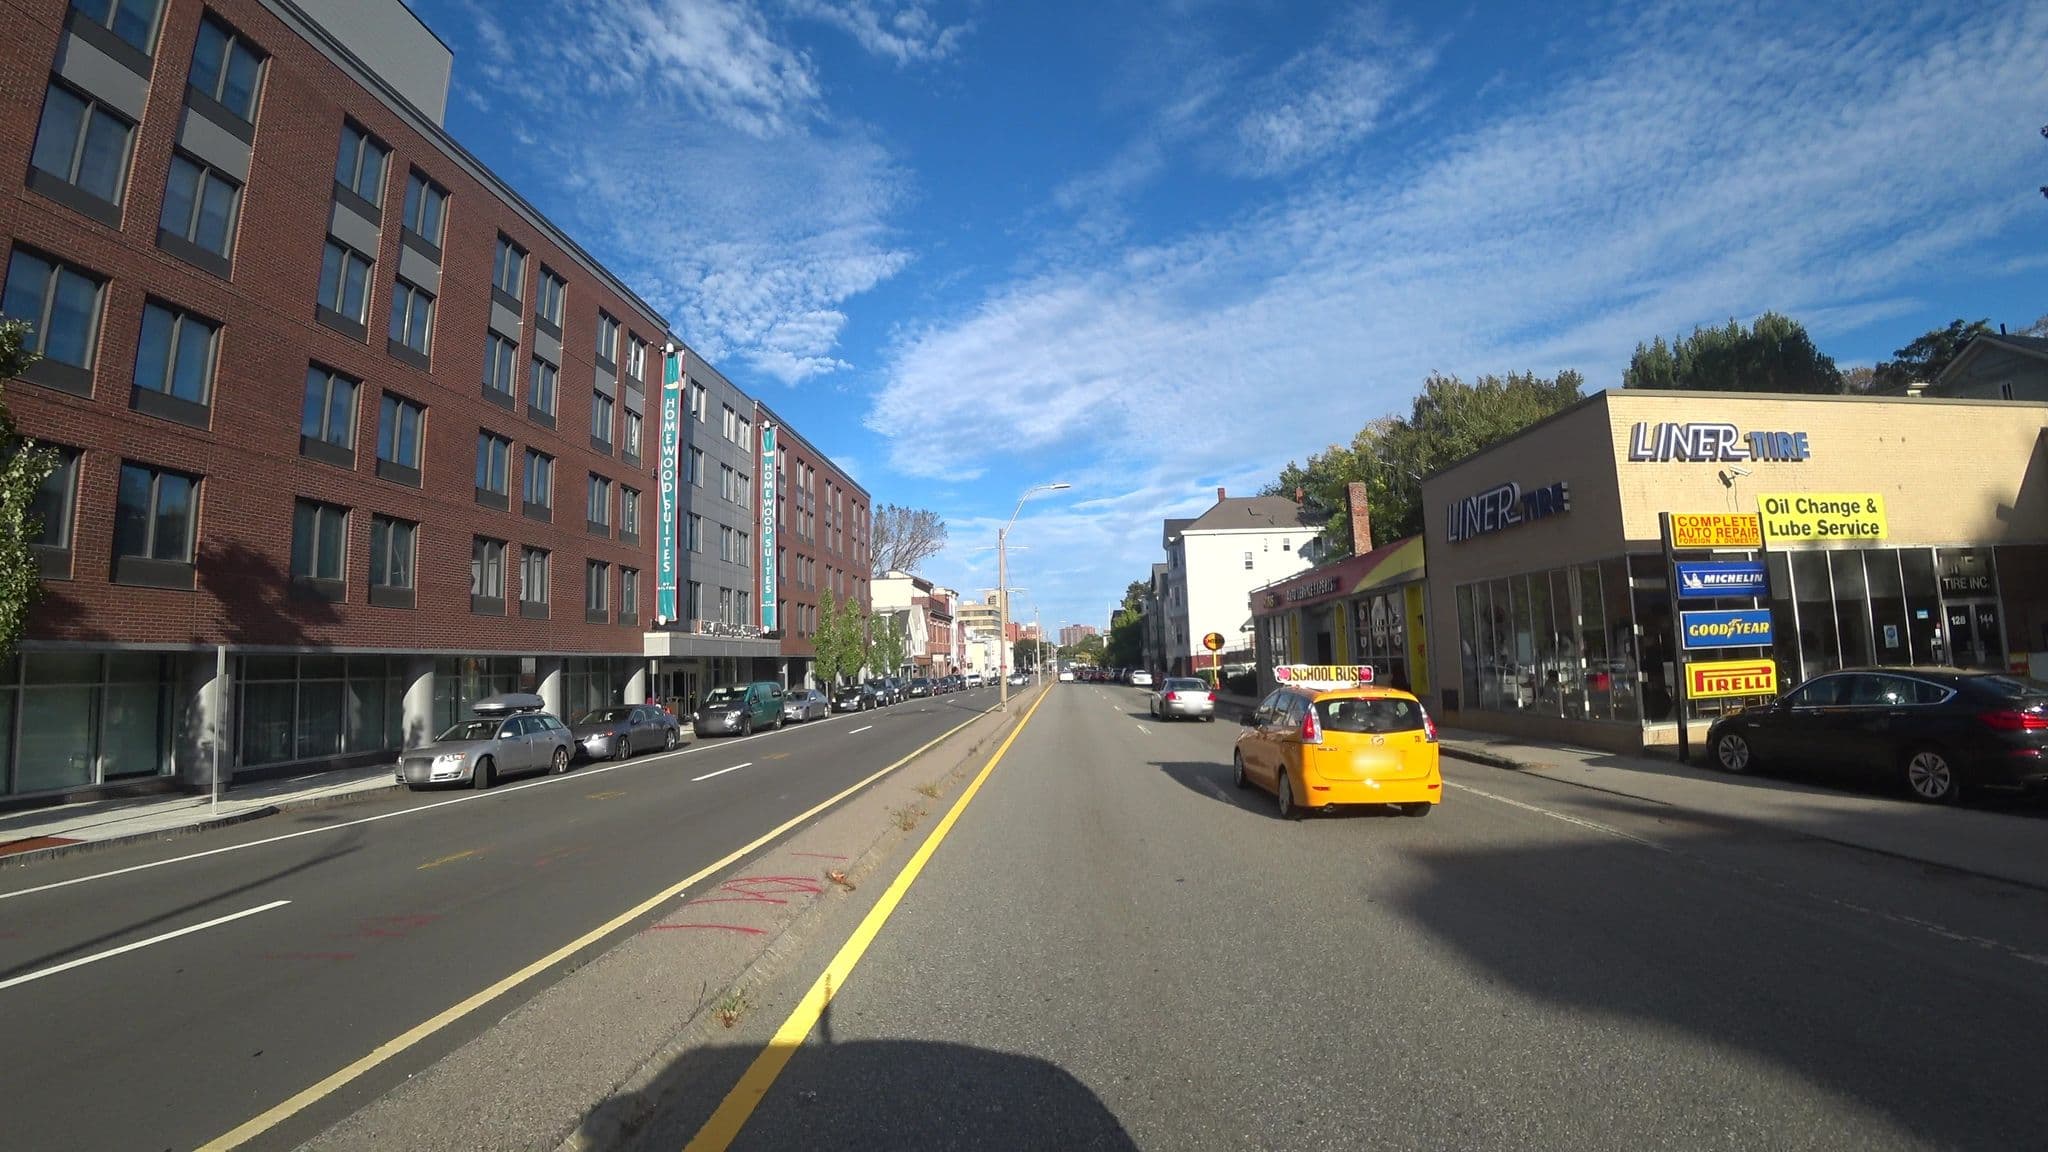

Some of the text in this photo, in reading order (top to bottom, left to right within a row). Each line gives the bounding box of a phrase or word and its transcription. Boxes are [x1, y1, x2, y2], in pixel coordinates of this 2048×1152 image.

[1628, 422, 1811, 462] LINER TIRE
[663, 398, 676, 573] HOMEWOOD SUITES
[763, 463, 774, 535] HOMEWOOD
[1765, 498, 1878, 517] Oil Change &
[1447, 480, 1521, 543] LINER
[1678, 516, 1757, 527] COMPLETE
[1768, 519, 1880, 536] Lube Service
[1678, 527, 1760, 539] AUTO REPAIR
[764, 538, 772, 594] SUITES
[1703, 573, 1764, 584] MICHELIN
[1943, 576, 1967, 591] TIRE
[1689, 620, 1770, 637] GOODYEAR
[1292, 666, 1358, 682] SCHOOL BUS
[1695, 666, 1772, 693] PIRELLI
